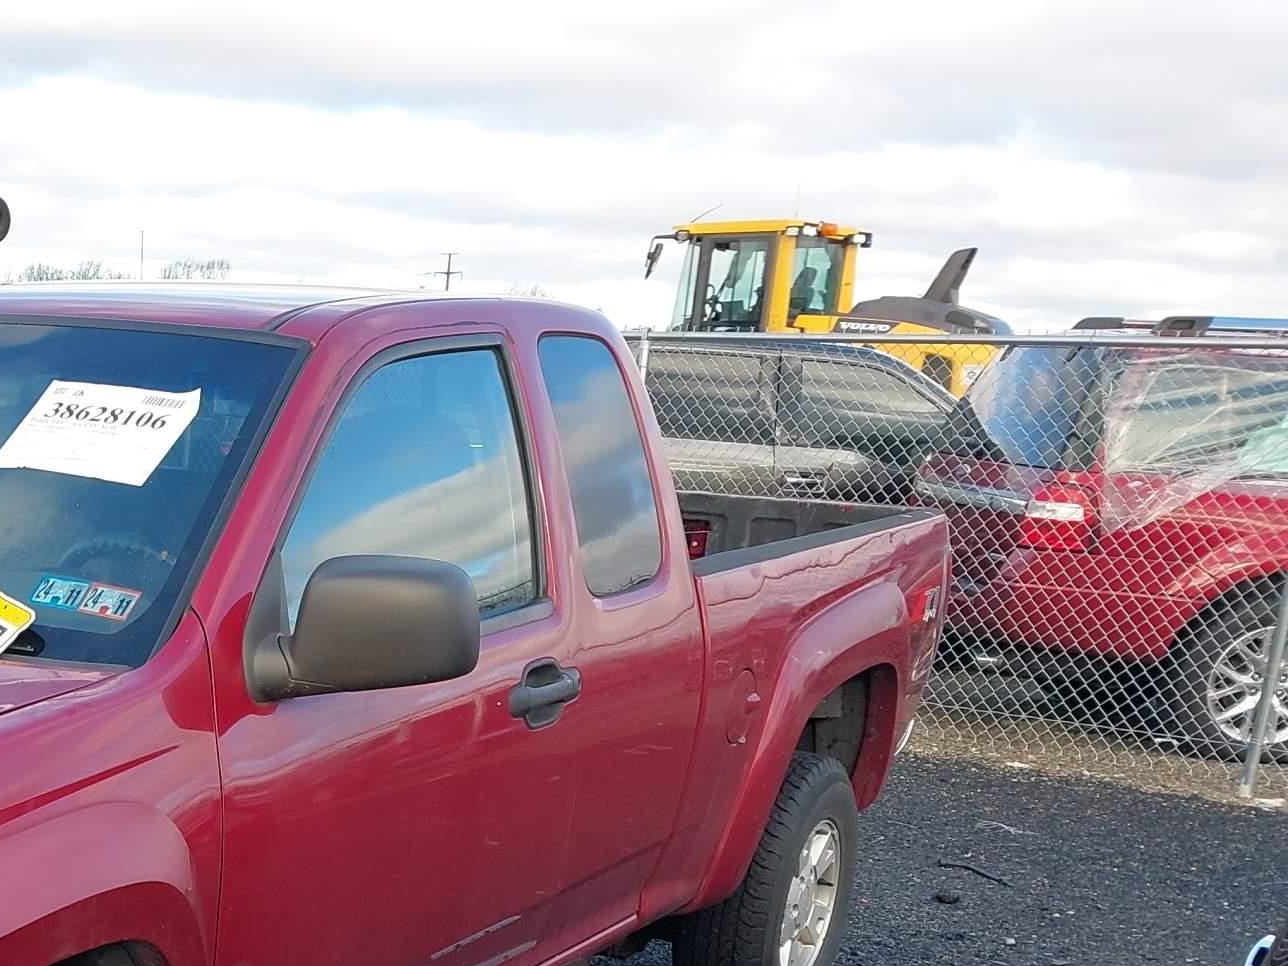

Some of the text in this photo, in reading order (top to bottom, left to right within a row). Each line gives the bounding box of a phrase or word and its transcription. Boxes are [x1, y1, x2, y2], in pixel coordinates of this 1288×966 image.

[840, 321, 891, 332] VOLVO
[44, 402, 172, 430] 38628106
[35, 579, 81, 606] 24 11
[83, 588, 133, 617] 24 11
